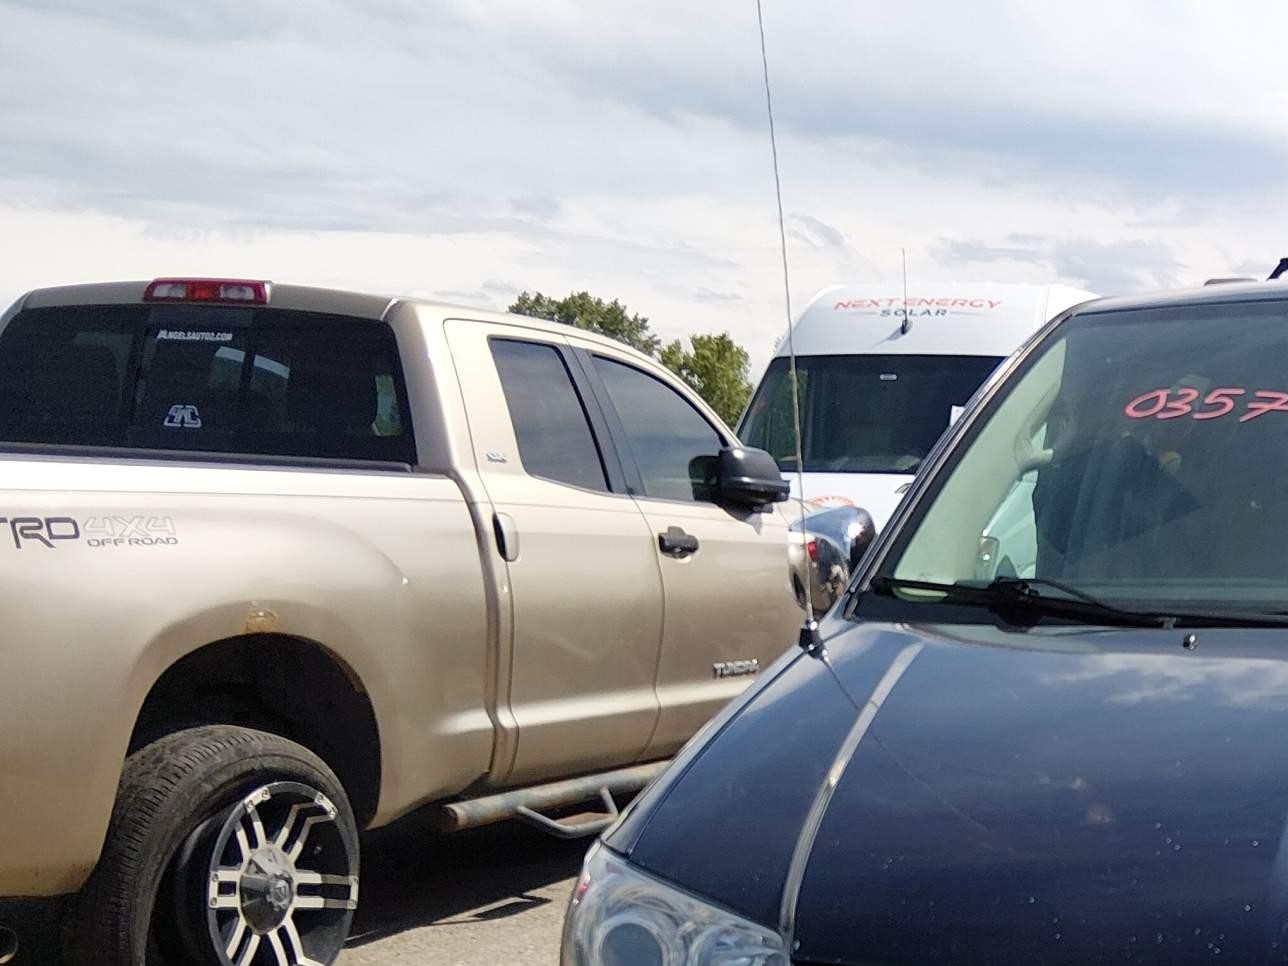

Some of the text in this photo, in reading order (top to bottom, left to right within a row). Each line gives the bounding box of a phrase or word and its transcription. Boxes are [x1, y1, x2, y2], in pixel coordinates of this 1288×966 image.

[879, 308, 948, 317] SOLAR
[87, 537, 179, 548] OFF ROAD
